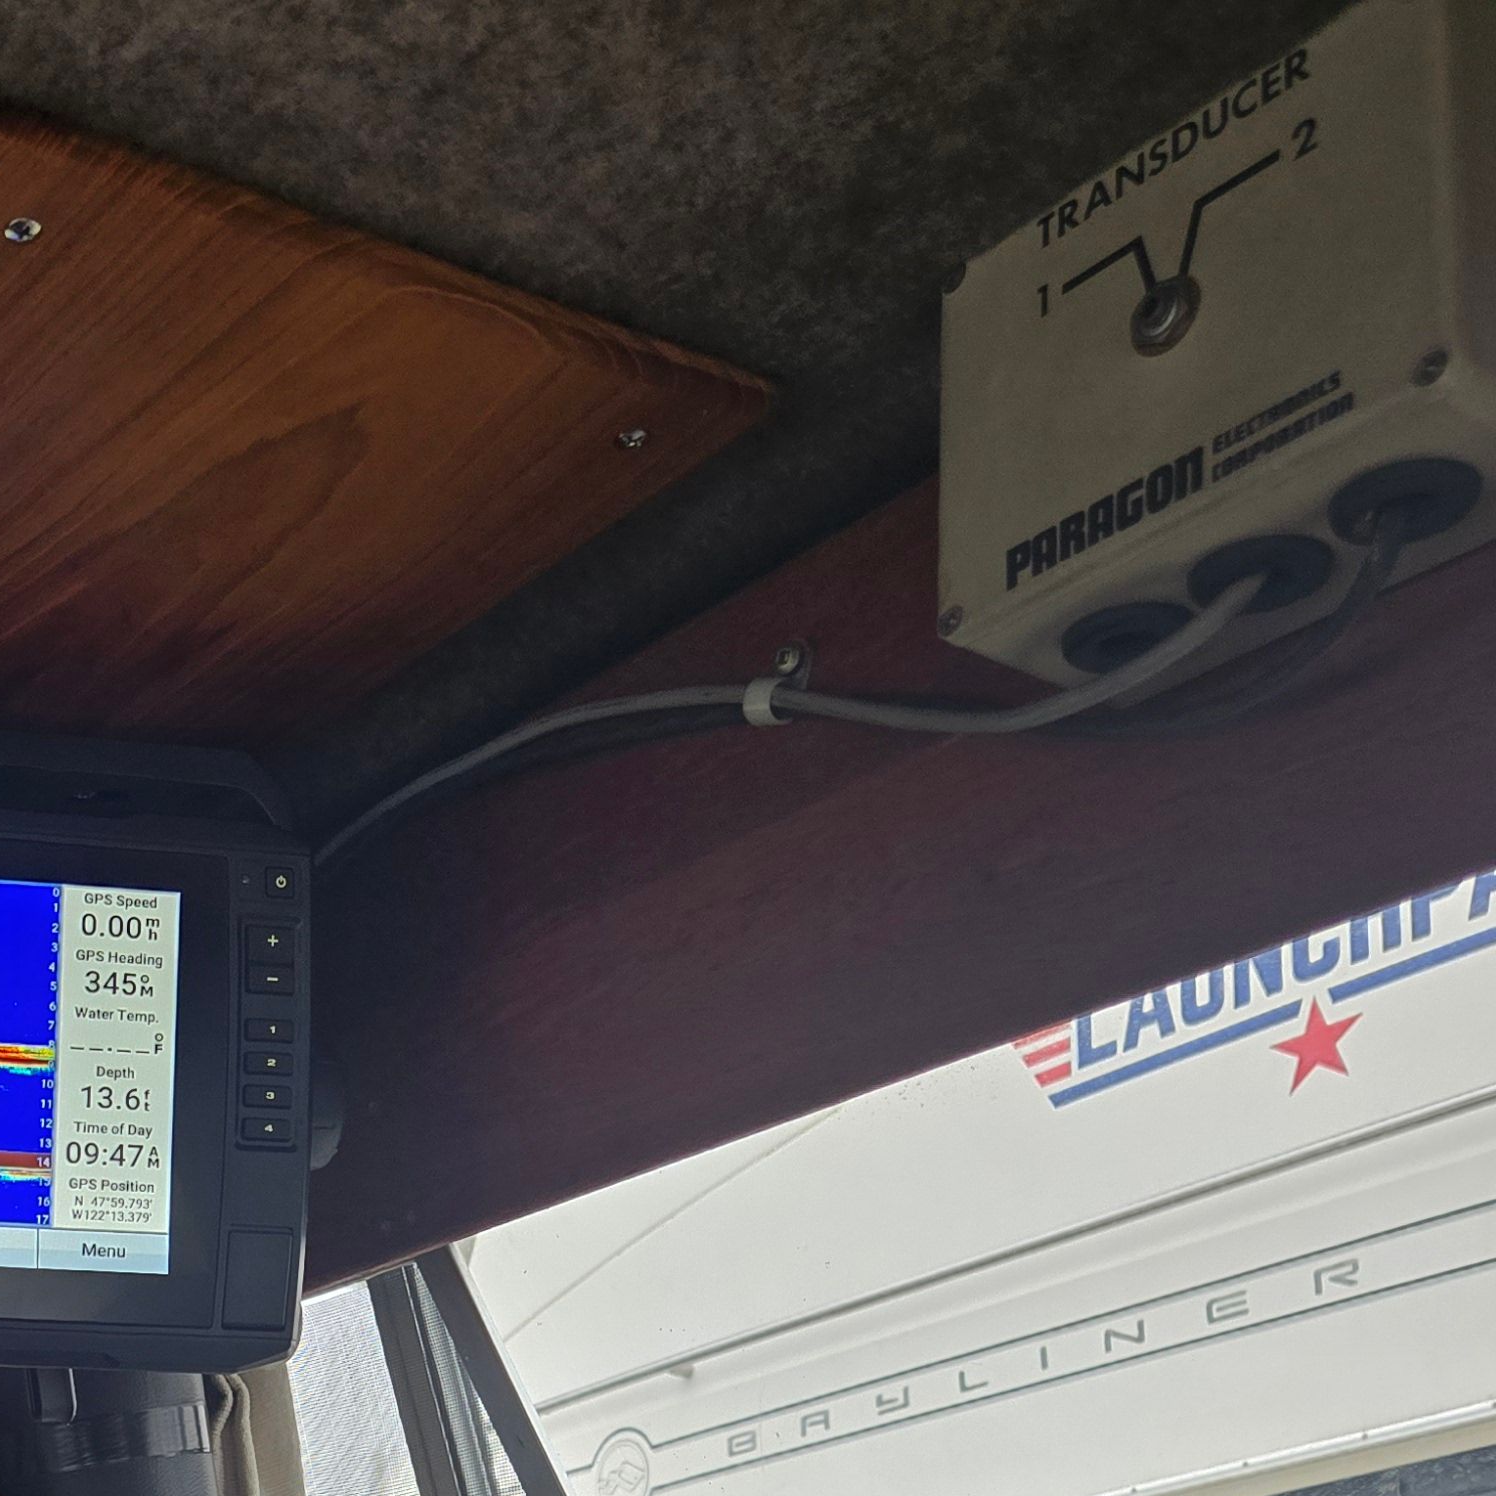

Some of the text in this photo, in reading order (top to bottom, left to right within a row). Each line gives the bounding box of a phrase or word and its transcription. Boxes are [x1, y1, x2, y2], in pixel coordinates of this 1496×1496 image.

[1292, 117, 1318, 161] 2
[1036, 48, 1309, 248] TRANSDUCER
[1036, 284, 1049, 318] 1
[1212, 370, 1341, 455] ELECTRONICS
[1212, 391, 1355, 483] CORPORATION
[1006, 445, 1204, 592] PARAGON
[52, 887, 60, 898] 0
[84, 892, 157, 909] GPS Speed
[51, 923, 59, 933] 2
[81, 913, 142, 939] 0.00
[50, 942, 58, 952] 3
[48, 962, 56, 972] 4
[75, 949, 163, 969] GPS Heading
[1077, 868, 1496, 1069] LAUNCHP
[49, 981, 57, 991] 5
[84, 970, 137, 996] 345
[74, 1006, 159, 1025] Water Temp.
[47, 1020, 55, 1030] 7
[96, 1065, 135, 1080] Depth
[41, 1079, 54, 1089] 10
[40, 1098, 53, 1109] 11
[80, 1085, 141, 1111] 13.6
[39, 1118, 53, 1129] 12
[73, 1121, 153, 1139] Time of Day
[38, 1138, 52, 1148] 13
[36, 1157, 50, 1167] 14
[65, 1141, 144, 1168] 09:47
[68, 1177, 155, 1194] GPS Position
[37, 1196, 50, 1207] 16
[81, 1242, 126, 1259] Menu
[727, 1258, 1359, 1459] BAYLINER
